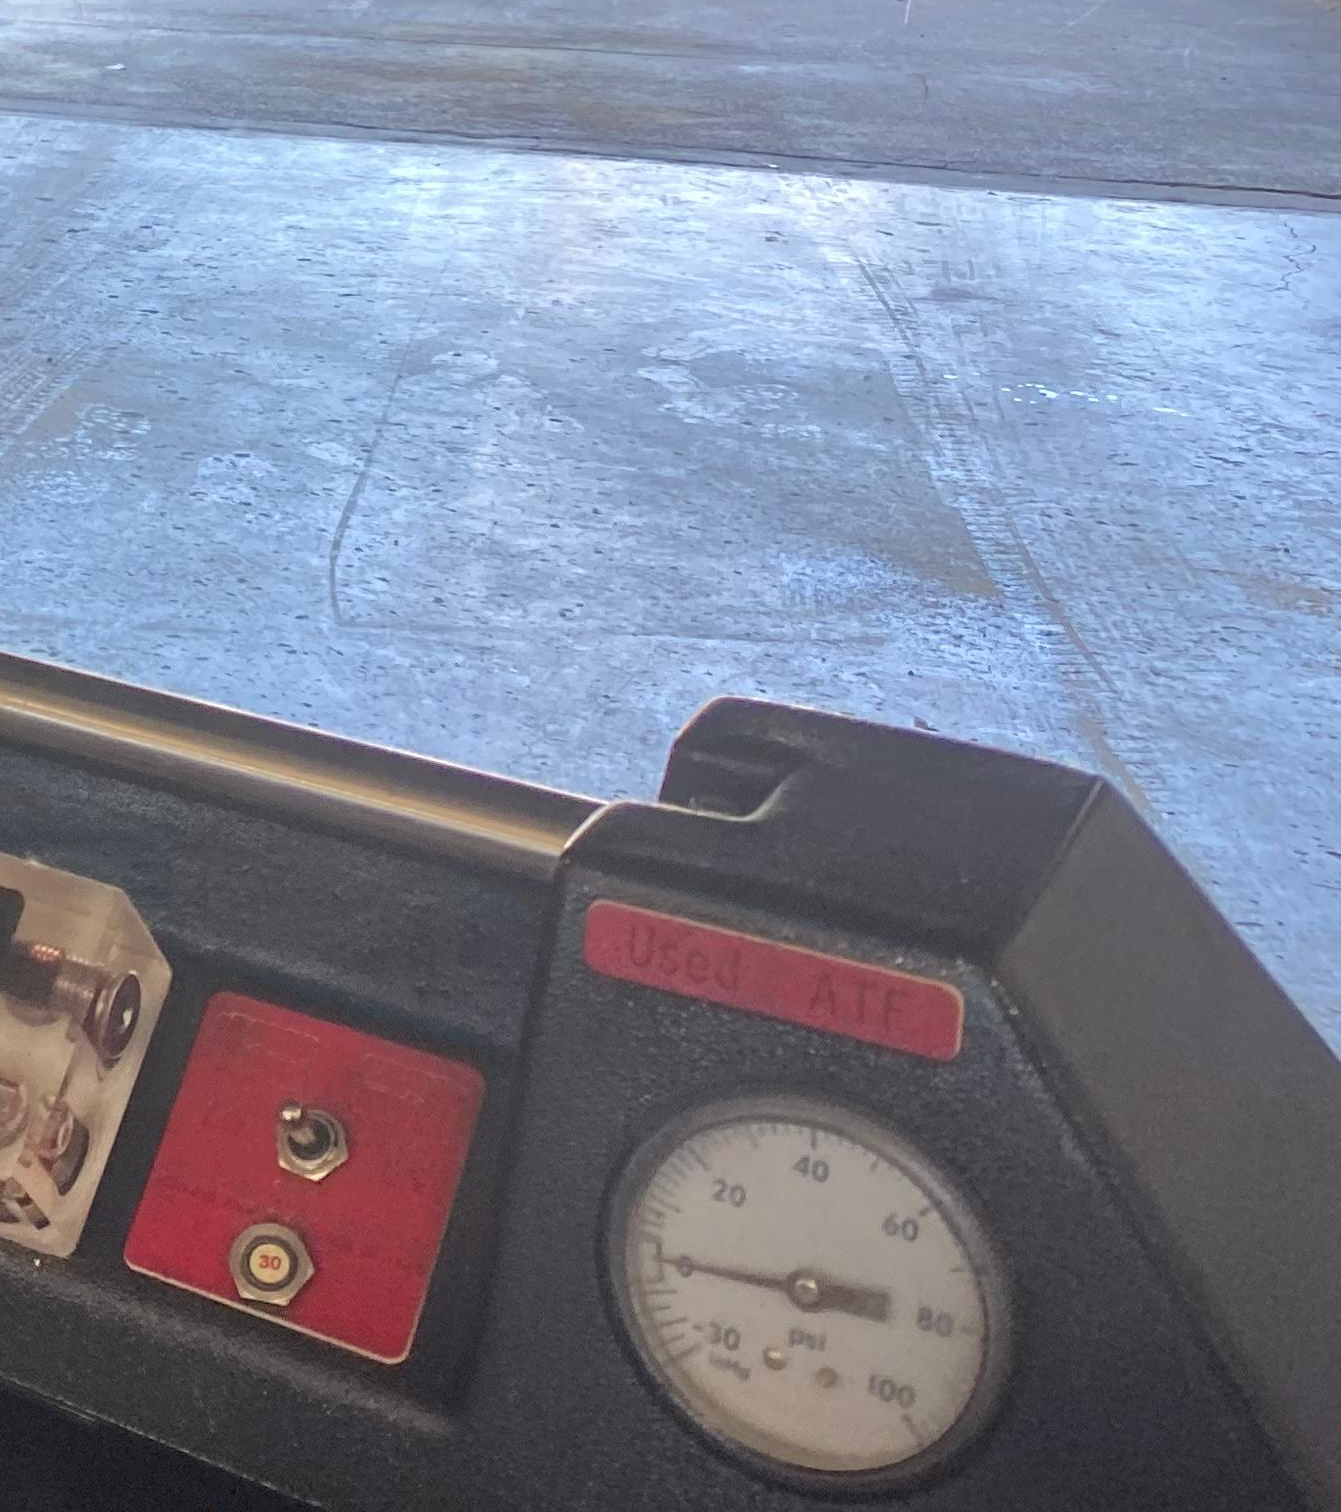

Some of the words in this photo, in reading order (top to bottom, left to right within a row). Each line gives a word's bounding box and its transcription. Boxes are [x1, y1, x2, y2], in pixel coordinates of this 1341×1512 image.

[627, 923, 743, 992] Used
[808, 967, 911, 1032] ATF
[791, 1153, 831, 1184] 40
[710, 1176, 748, 1209] 20
[881, 1211, 919, 1243] 60
[258, 1254, 282, 1272] 30
[914, 1305, 955, 1339] 80
[787, 1325, 829, 1353] psi
[867, 1372, 917, 1410] 100
